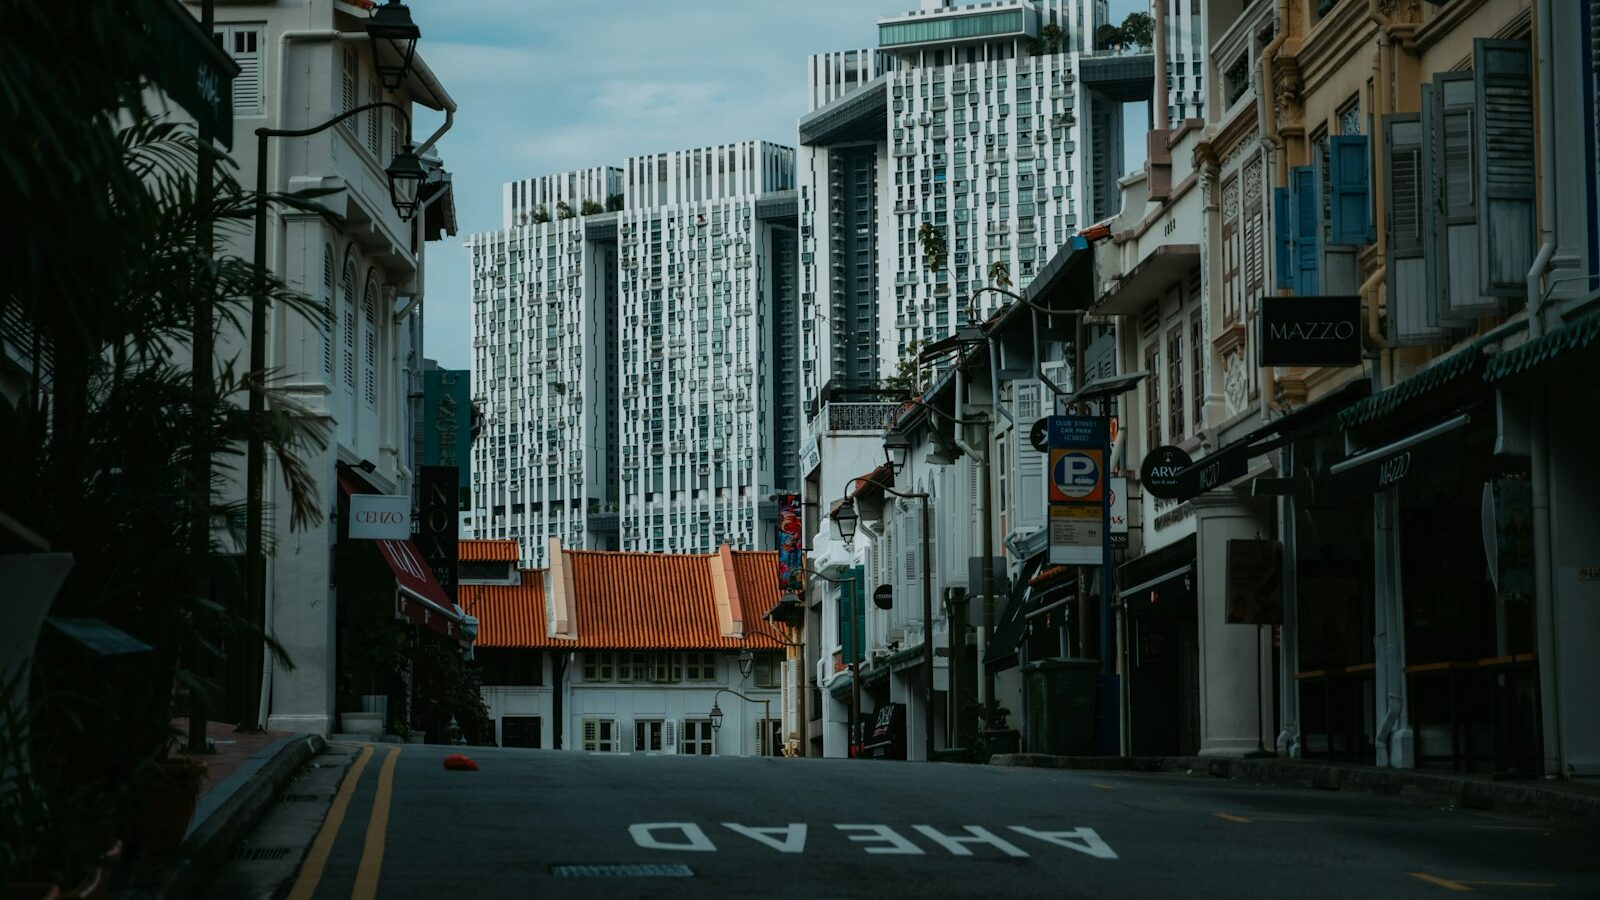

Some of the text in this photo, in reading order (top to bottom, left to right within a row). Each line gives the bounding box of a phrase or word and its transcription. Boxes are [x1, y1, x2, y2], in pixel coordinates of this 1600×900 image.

[1270, 320, 1354, 340] MAZZO
[1074, 420, 1097, 428] STREET
[1379, 452, 1411, 487] MAZZO
[428, 483, 449, 559] NOX
[627, 821, 1120, 859] AHEAD
